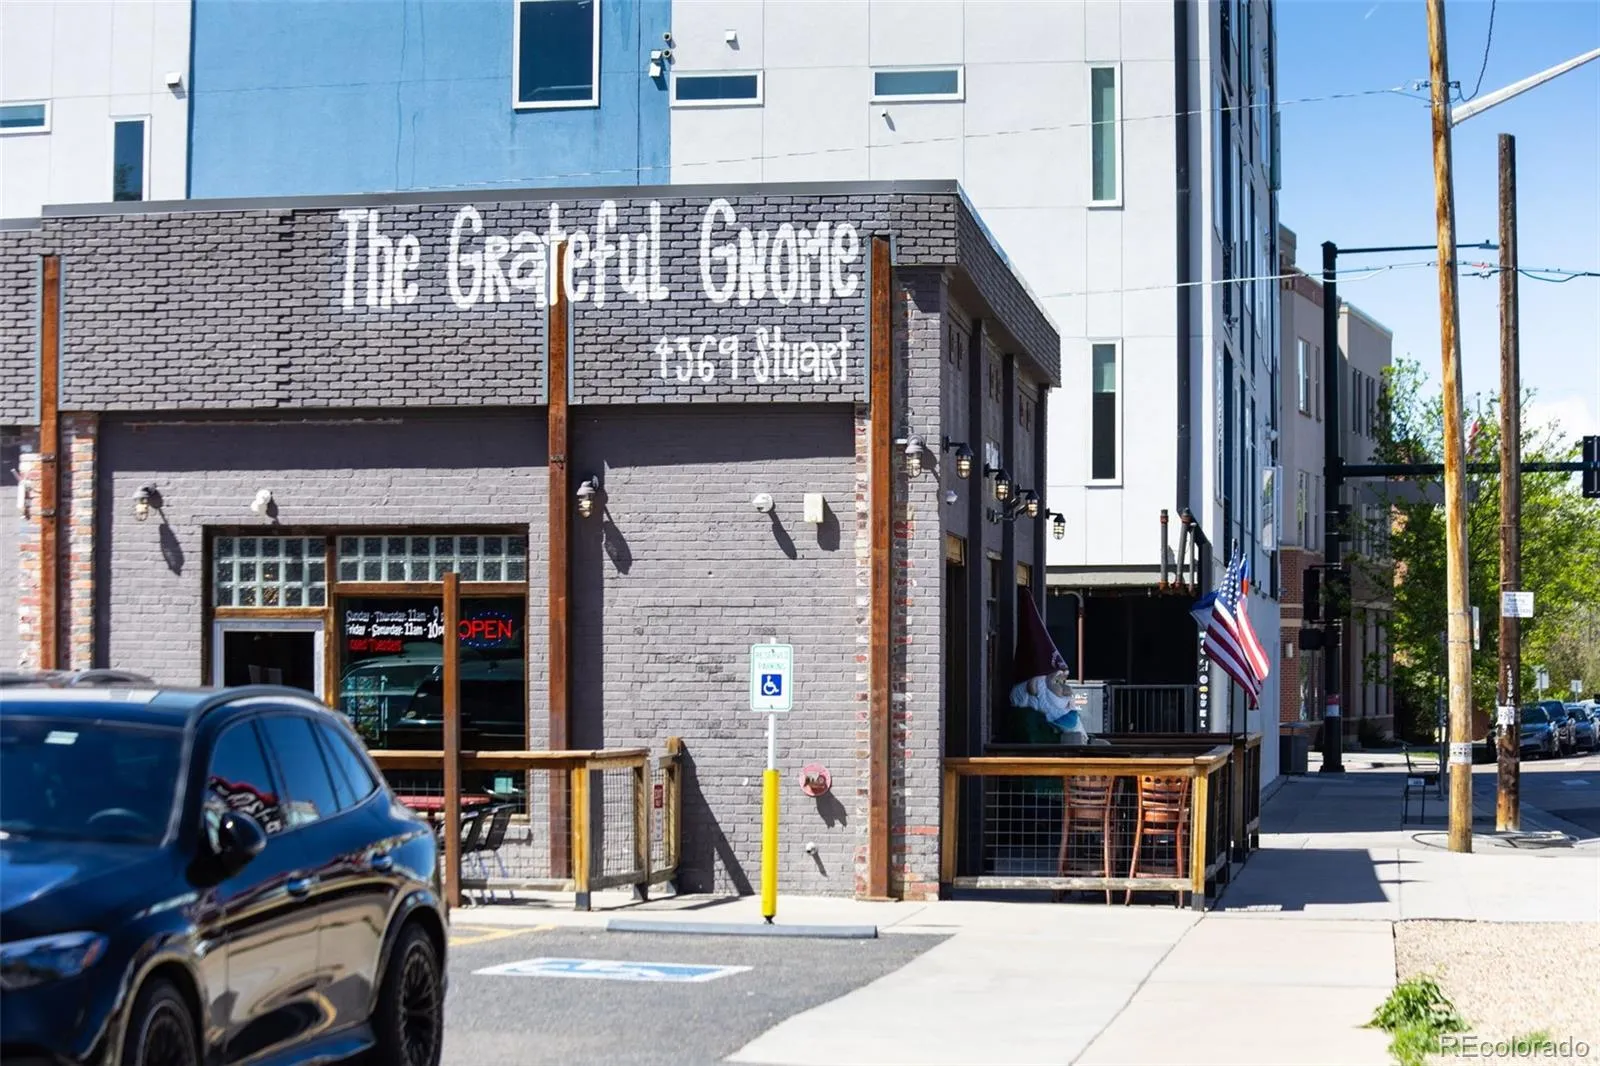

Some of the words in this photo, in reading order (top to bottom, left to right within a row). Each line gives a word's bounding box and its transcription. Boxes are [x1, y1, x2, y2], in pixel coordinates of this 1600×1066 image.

[338, 207, 421, 310] The
[447, 199, 670, 309] Grateful
[698, 197, 861, 307] Gnome
[654, 334, 739, 383] 4369
[752, 325, 851, 383] Stuart
[456, 619, 512, 639] OPEN
